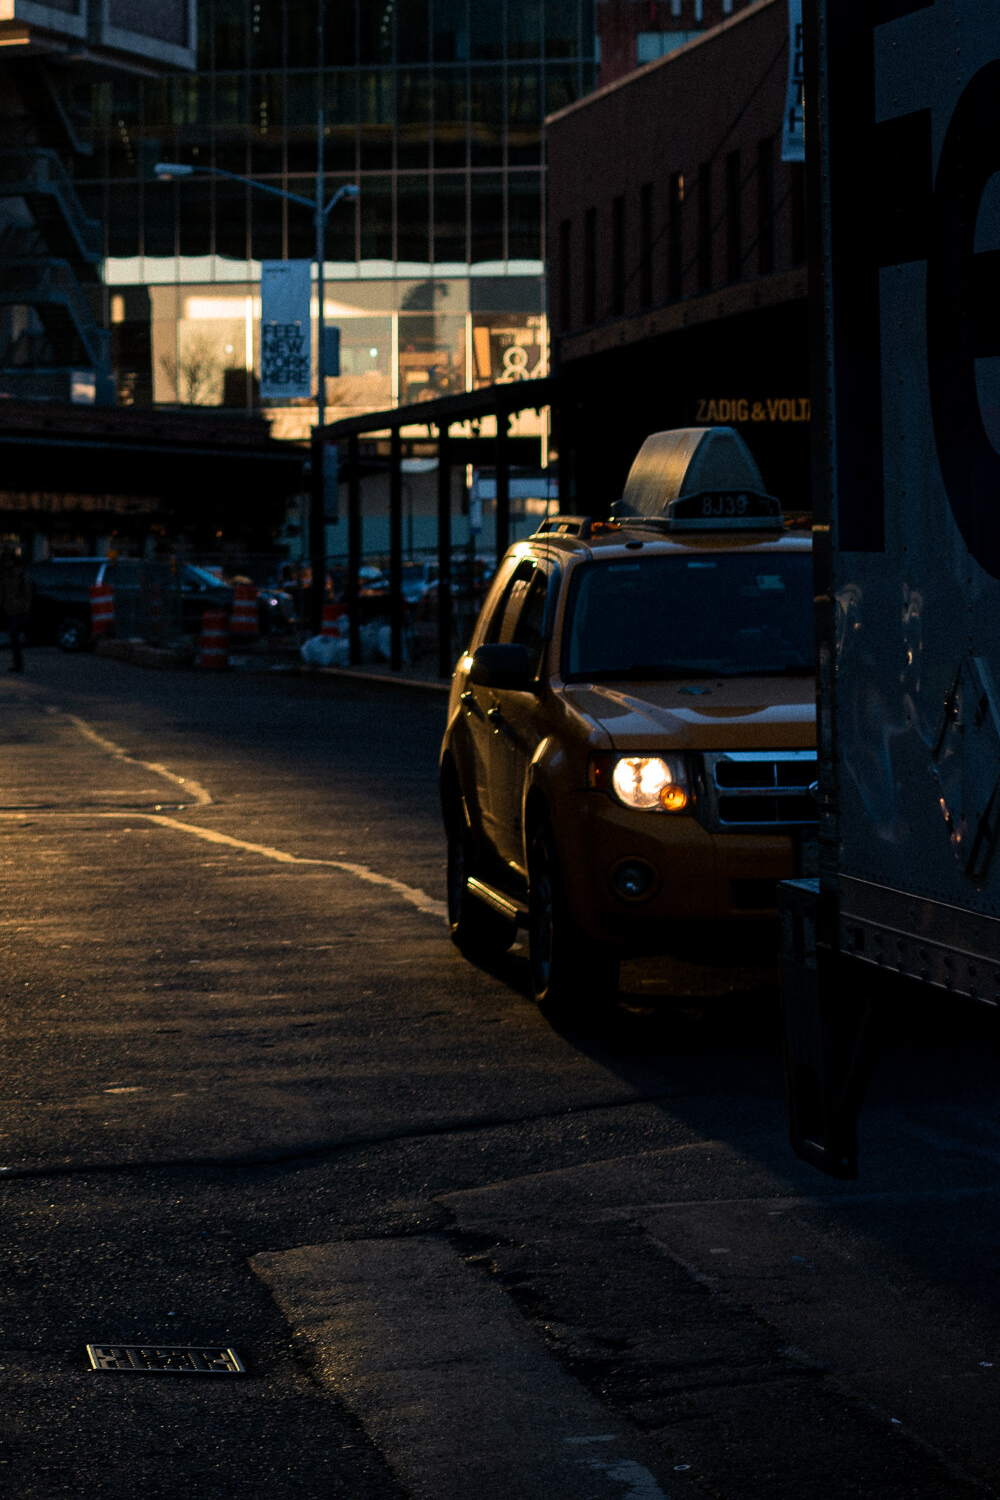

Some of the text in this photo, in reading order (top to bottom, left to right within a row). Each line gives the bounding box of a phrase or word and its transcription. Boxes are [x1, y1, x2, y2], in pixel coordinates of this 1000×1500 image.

[263, 324, 303, 338] FEEL
[263, 339, 304, 355] NEW
[263, 354, 310, 370] YORK
[263, 369, 308, 384] HERE
